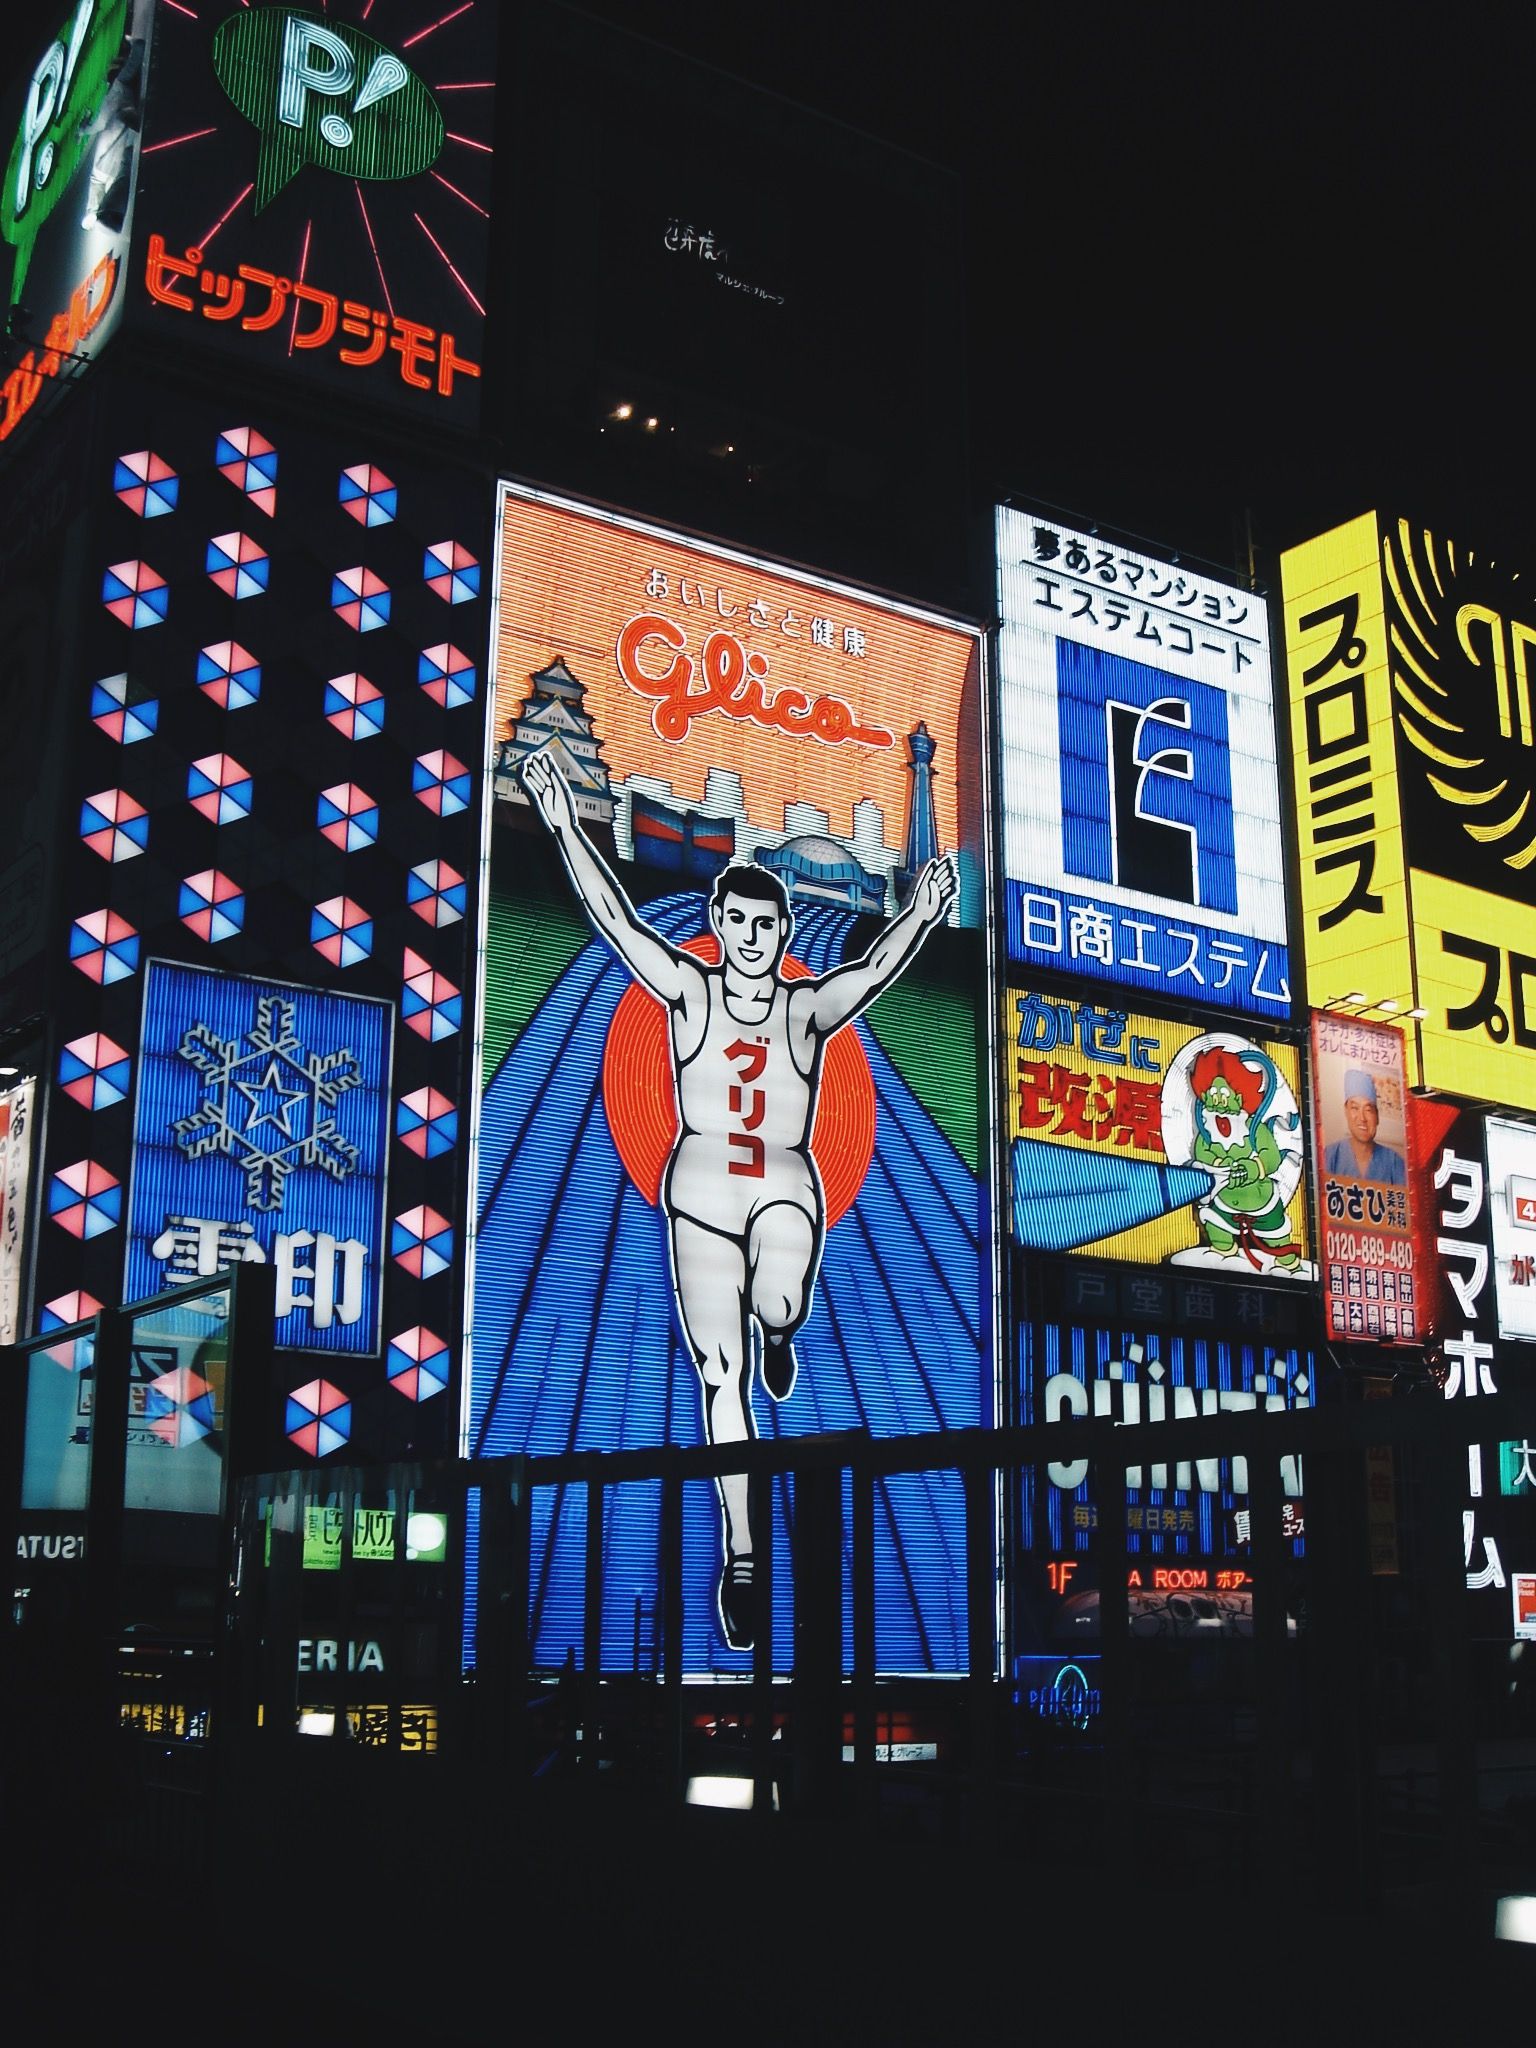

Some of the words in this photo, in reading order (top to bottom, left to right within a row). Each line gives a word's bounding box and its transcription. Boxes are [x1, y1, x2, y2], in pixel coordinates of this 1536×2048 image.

[145, 234, 481, 397] ピップフジモト
[646, 568, 866, 658] おいしさと健康
[1032, 526, 1248, 624] 夢あるマンション
[1035, 577, 1252, 673] エステムコート
[616, 611, 896, 750] Glico
[1299, 592, 1384, 933] プロミス
[1022, 893, 1291, 1003] 日商エステム
[1017, 994, 1161, 1072] かぜに
[723, 1036, 770, 1179] グリコ
[1017, 1056, 1163, 1152] 改源
[1326, 1179, 1385, 1224] あさひ
[152, 1213, 369, 1330] 雪印
[1327, 1230, 1413, 1270] 0120-889-480
[1434, 1148, 1506, 1589] タマホーム
[1073, 1505, 1195, 1532] 毎曜日発売
[1047, 1562, 1078, 1594] 1F
[1154, 1570, 1207, 1589] ROOM
